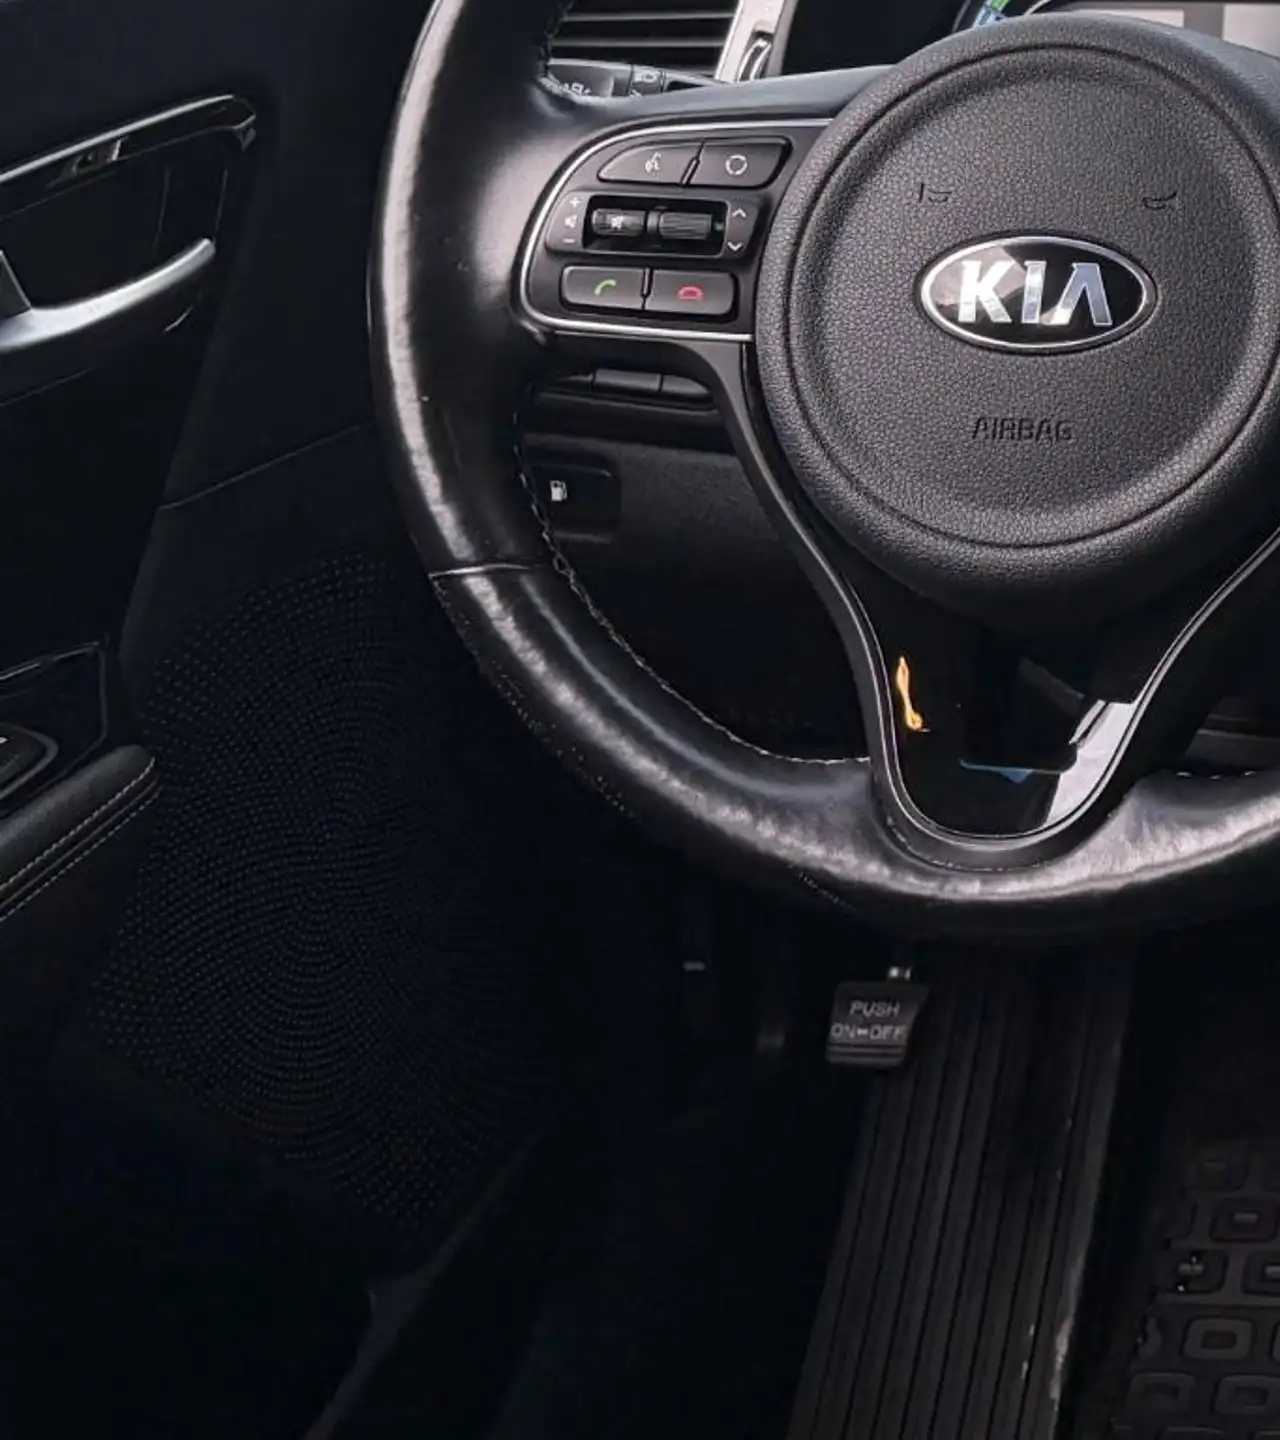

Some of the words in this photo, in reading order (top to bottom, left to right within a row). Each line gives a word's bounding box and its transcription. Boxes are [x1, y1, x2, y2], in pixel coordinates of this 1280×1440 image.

[957, 260, 1113, 326] KIA
[971, 417, 1072, 442] AIRBAG
[850, 1000, 900, 1018] PUSH
